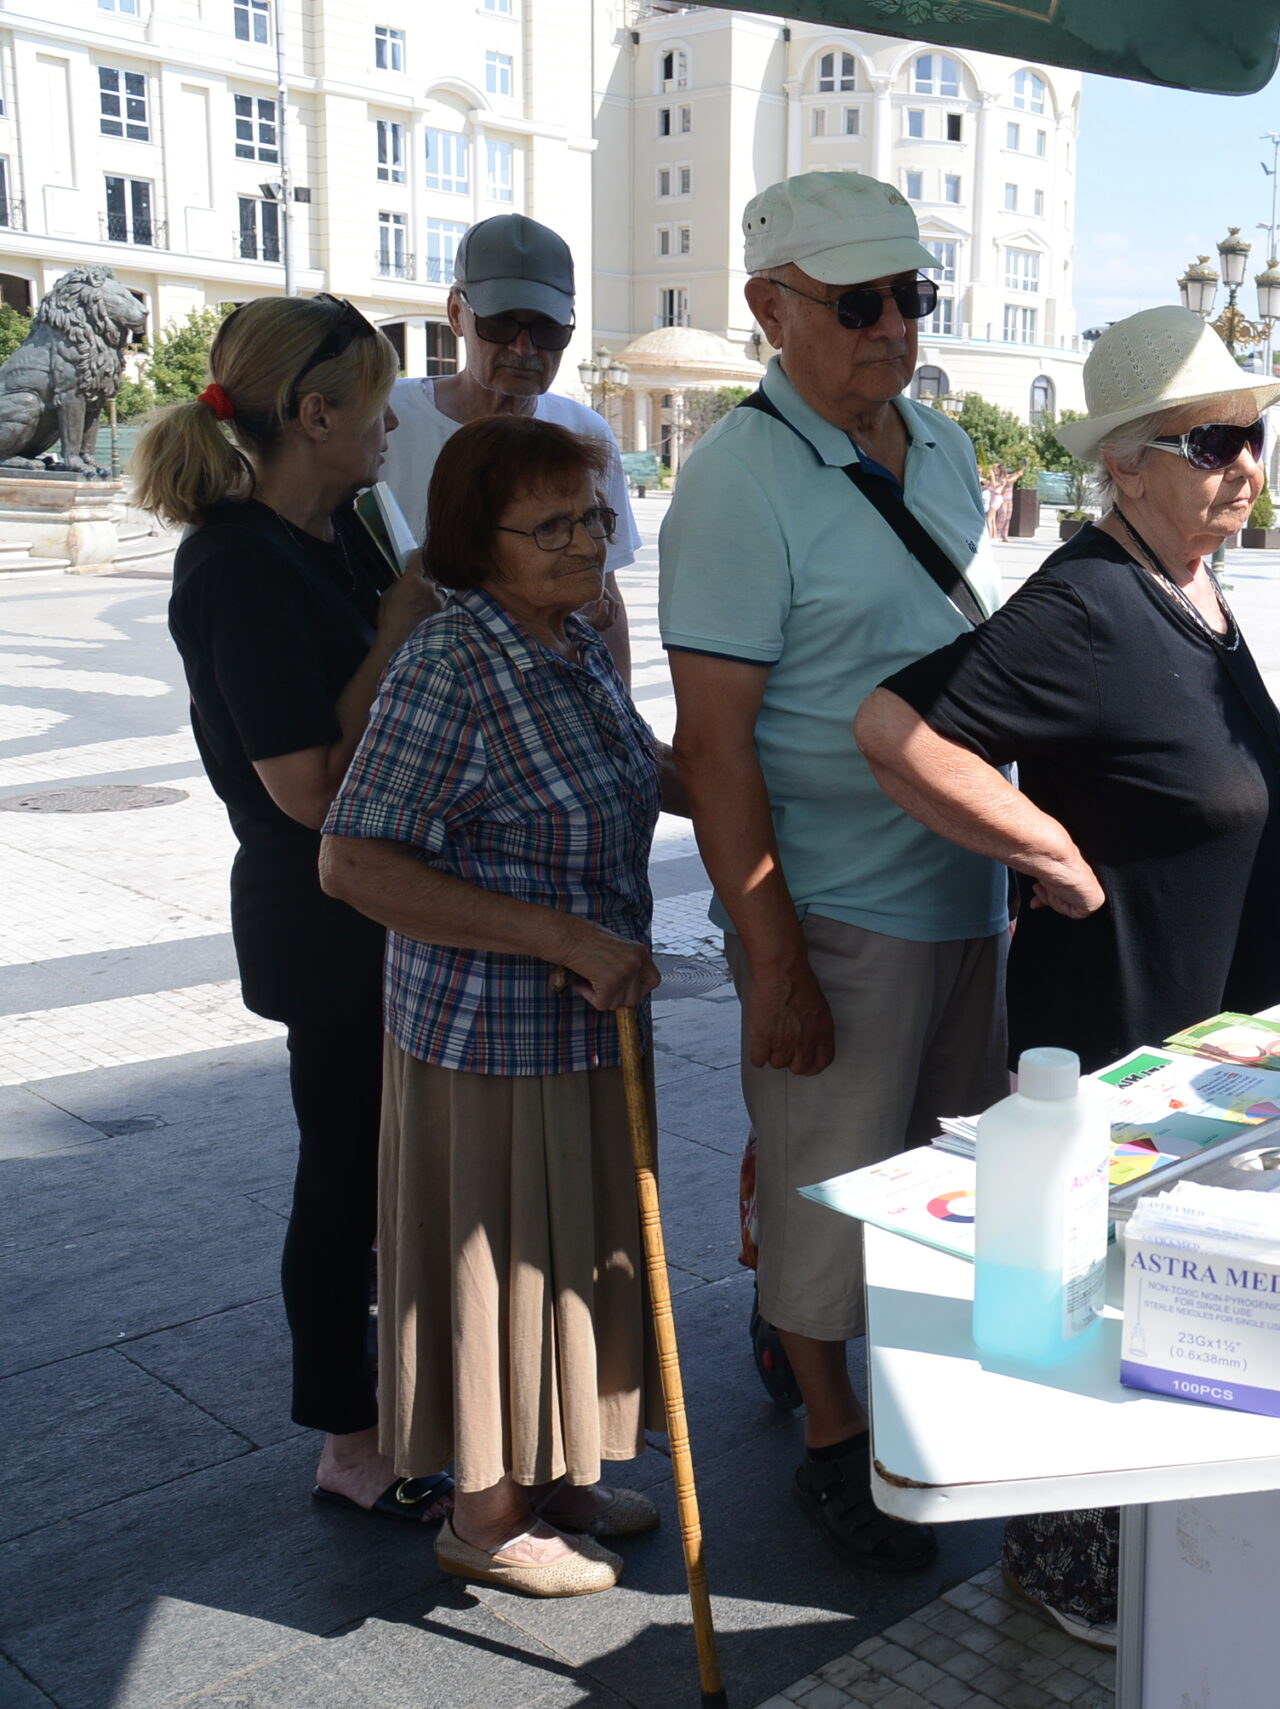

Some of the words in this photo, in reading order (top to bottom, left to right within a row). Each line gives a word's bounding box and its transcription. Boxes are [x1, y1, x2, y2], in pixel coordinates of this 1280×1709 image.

[1131, 1251, 1217, 1284] ASTRA
[1148, 1281, 1199, 1299] NON-TOXIC
[1175, 1296, 1194, 1307] FOR
[1196, 1300, 1231, 1314] SINGLE
[1233, 1307, 1253, 1317] USE
[1173, 1380, 1234, 1401] 100PCS
